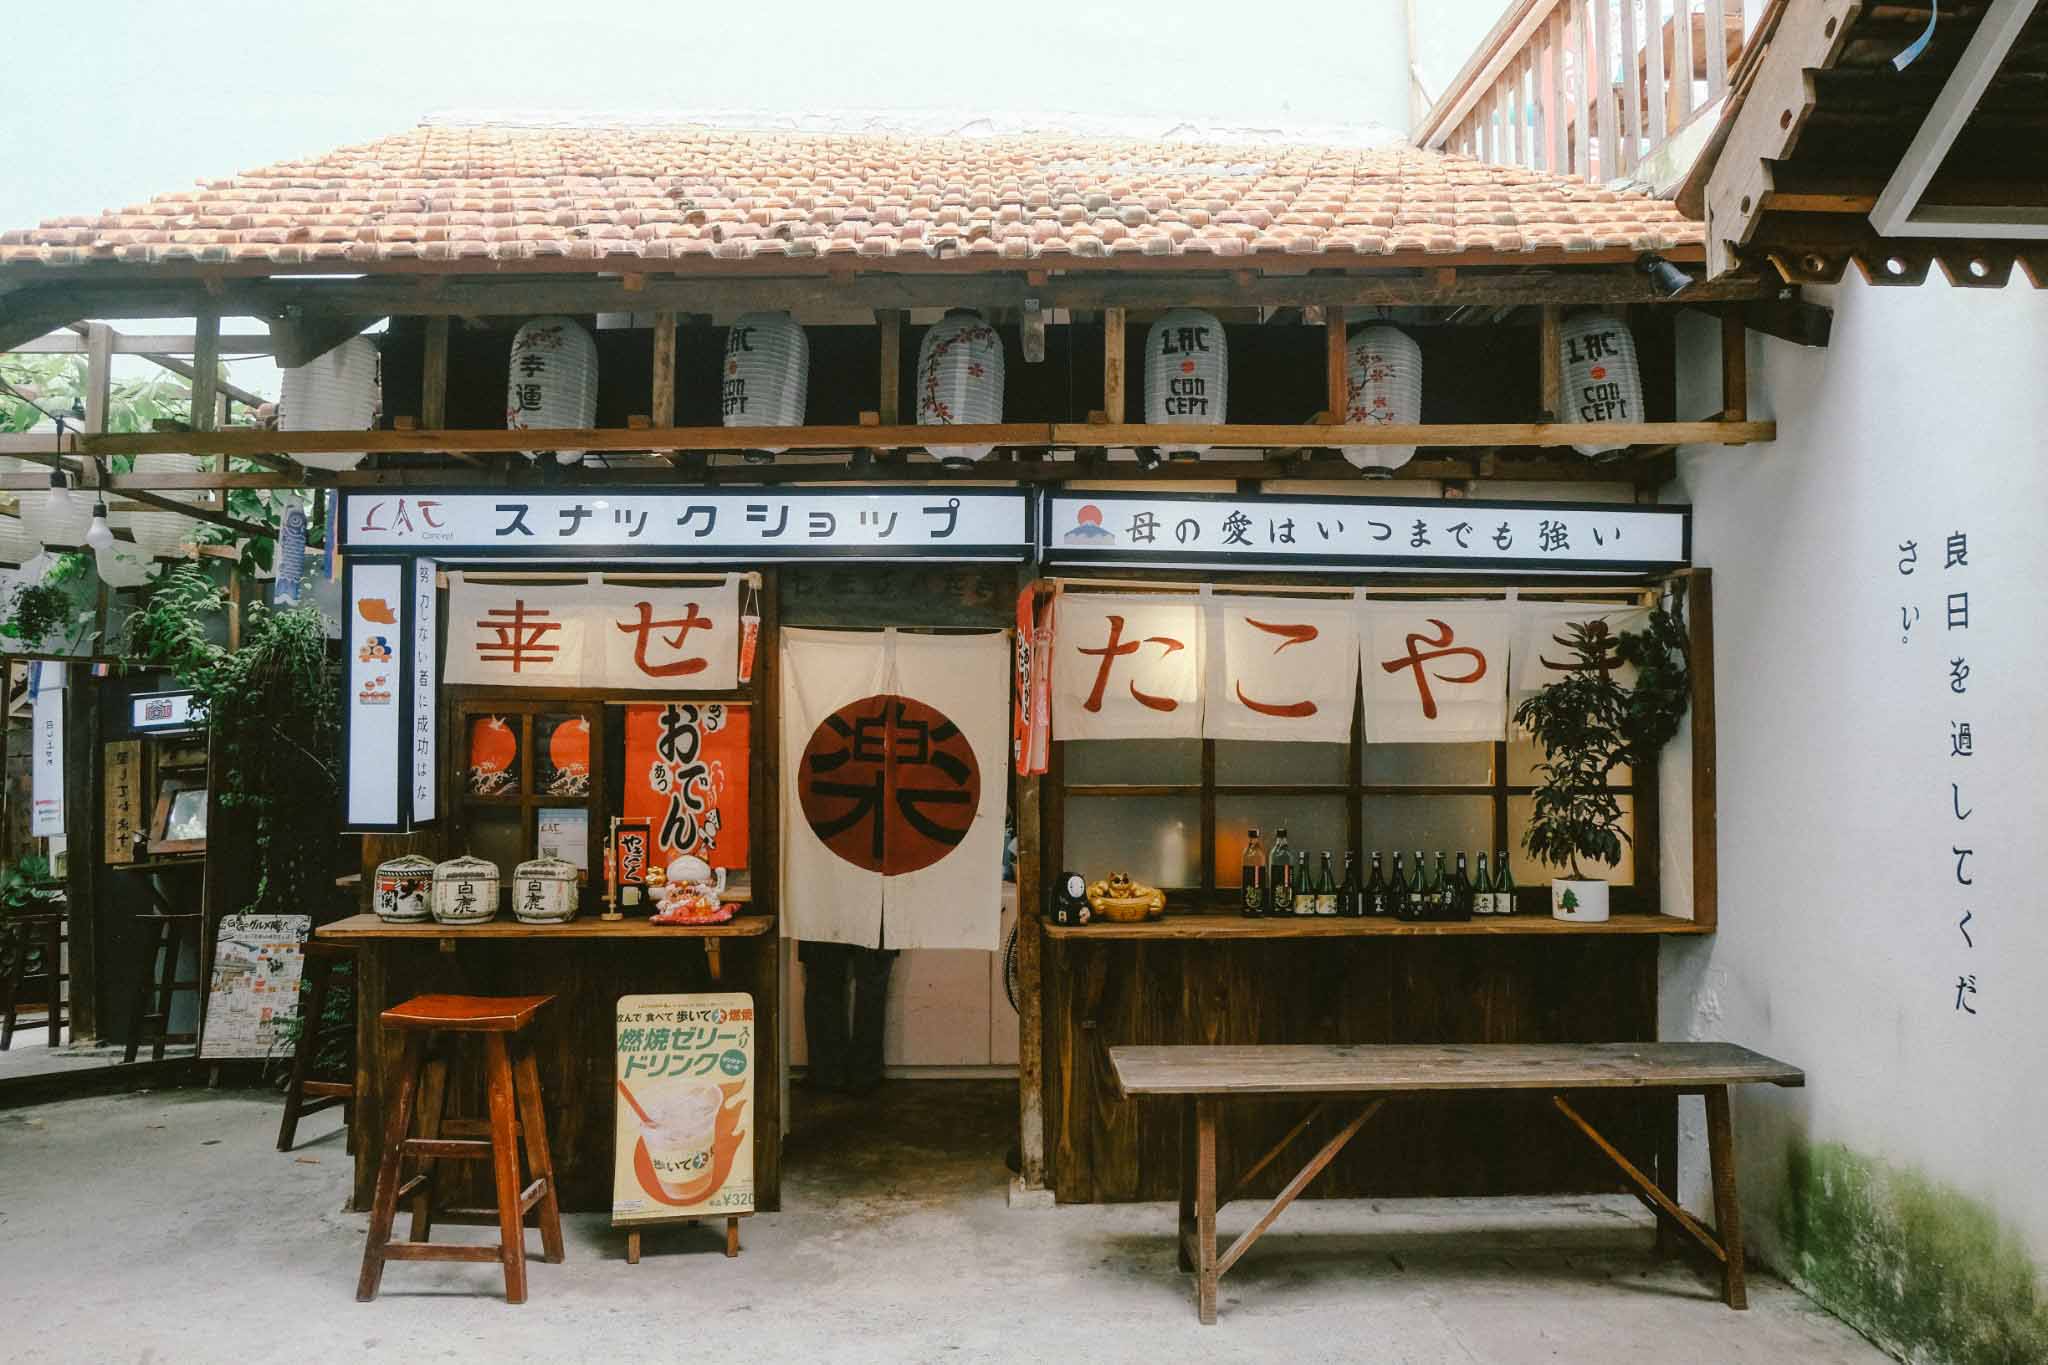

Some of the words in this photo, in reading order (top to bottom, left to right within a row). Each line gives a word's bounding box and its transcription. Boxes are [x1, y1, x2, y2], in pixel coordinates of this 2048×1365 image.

[1165, 397, 1209, 416] CEPT
[1580, 400, 1627, 422] CEPT
[496, 497, 960, 539] スナックショップ
[1125, 509, 1621, 552] 母の愛はいつまでも強い
[475, 599, 714, 678] 幸せ
[653, 765, 668, 792] あつ
[658, 703, 708, 850] おでん
[1943, 529, 1977, 1015] 良日を過してくだ
[618, 1026, 737, 1052] 燃焼ゼリー
[624, 1052, 720, 1079] ドリンク
